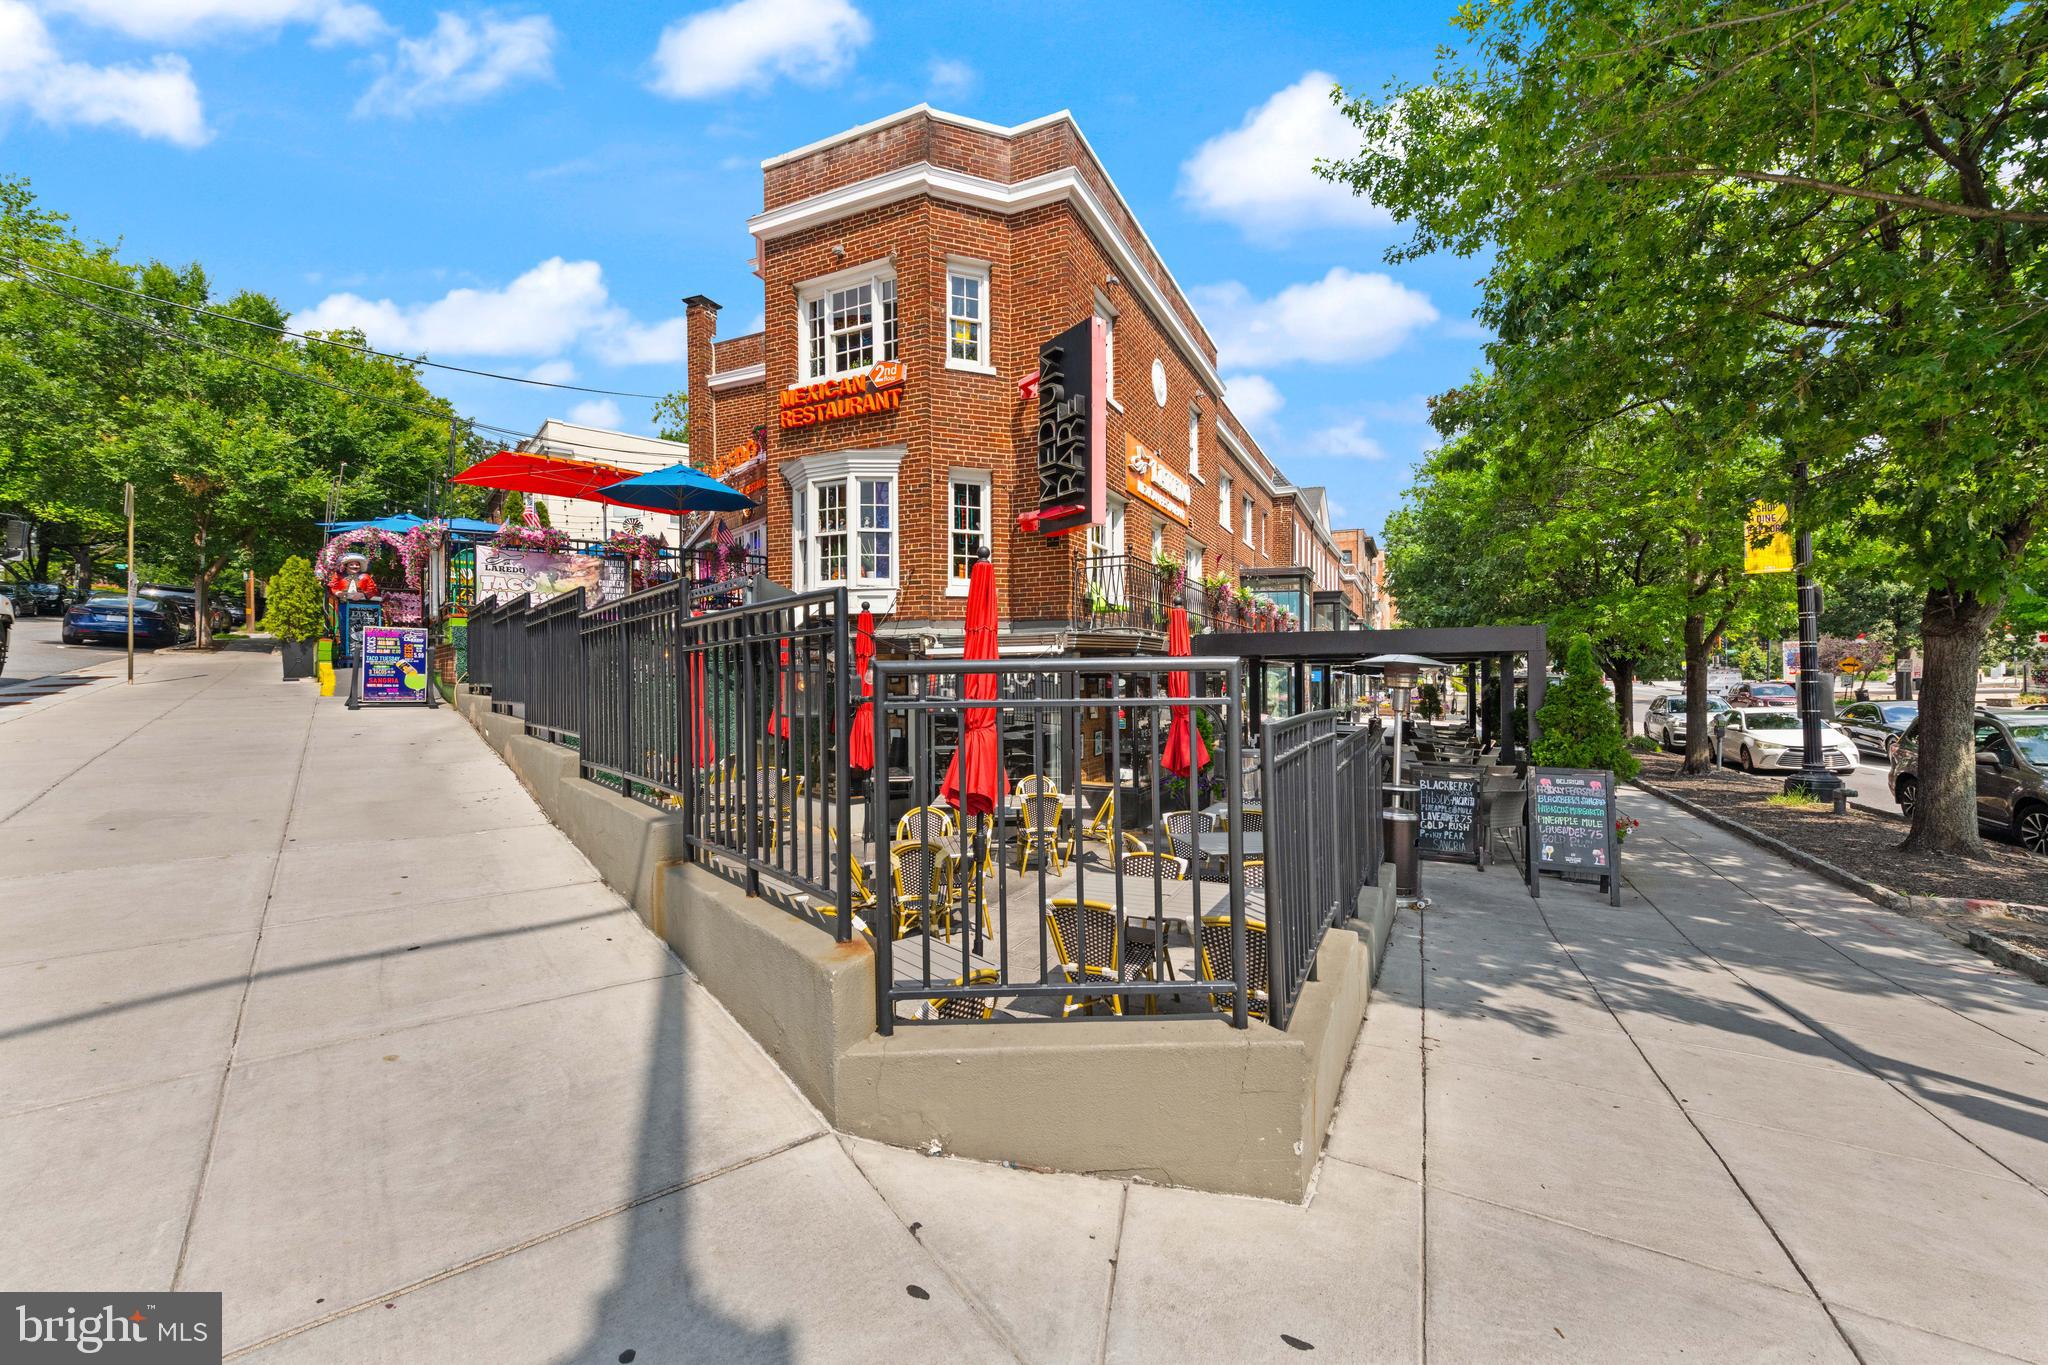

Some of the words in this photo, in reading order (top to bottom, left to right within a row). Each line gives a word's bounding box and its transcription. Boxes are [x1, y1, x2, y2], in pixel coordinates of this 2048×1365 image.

[875, 364, 897, 382] 2nd
[780, 374, 867, 408] MEXICAN
[780, 388, 903, 428] RESTAURANT
[1038, 346, 1064, 502] MEDIUM
[1057, 393, 1085, 497] RARE
[1756, 504, 1778, 512] SHOP
[1756, 514, 1776, 522] DINE
[485, 565, 526, 574] LAREDO
[480, 575, 537, 592] TACO
[1420, 780, 1474, 792] BLACKBERRY
[1420, 820, 1444, 829] GOLD
[1449, 822, 1470, 831] RUSH
[1461, 815, 1472, 824] 75
[1537, 815, 1578, 825] PINEAPPLE
[1581, 818, 1603, 828] MULE
[1444, 831, 1464, 840] PEAR
[1539, 825, 1586, 837] LAVENDER
[1588, 829, 1603, 839] 75
